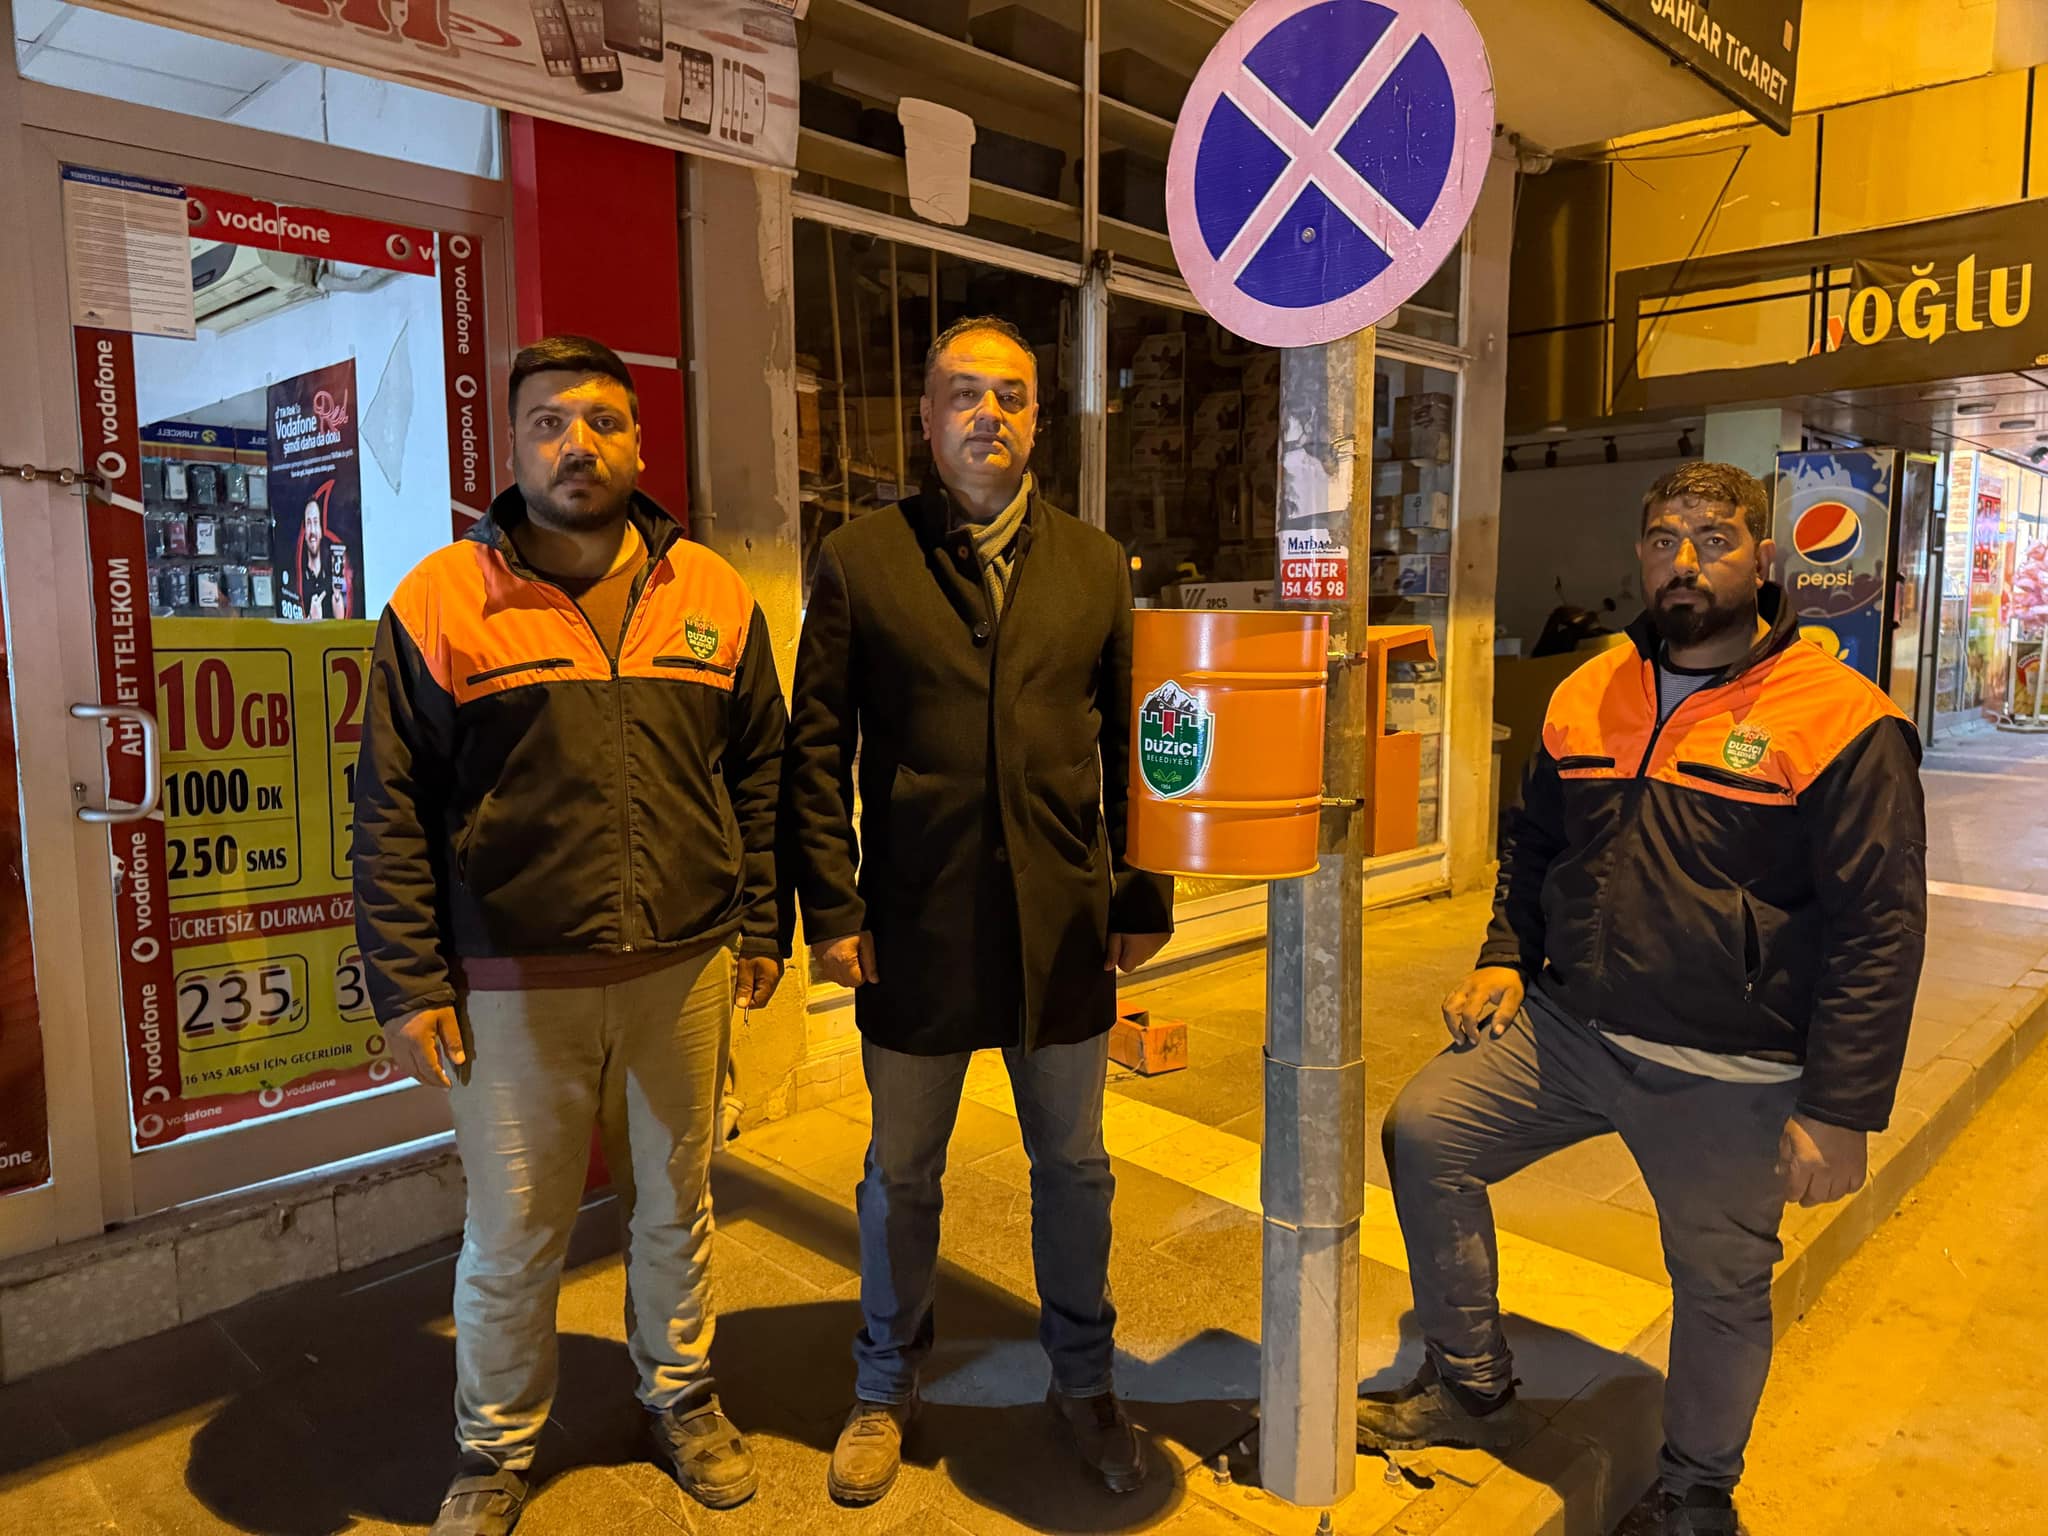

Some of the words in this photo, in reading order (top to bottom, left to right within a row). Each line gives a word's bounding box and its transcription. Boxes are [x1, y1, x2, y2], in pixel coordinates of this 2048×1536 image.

[216, 210, 331, 244] vodafone
[454, 265, 472, 355] vodafone
[94, 339, 119, 444] vodafone
[275, 415, 317, 440] Vodafone
[461, 405, 478, 492] vodafone
[1287, 562, 1339, 578] CENTER
[1304, 581, 1322, 596] 45
[1326, 581, 1345, 597] 98
[1796, 569, 1853, 590] pepsi
[108, 558, 136, 664] TELEKOM
[158, 658, 235, 752] 10
[241, 692, 291, 748] GB
[1144, 738, 1198, 758] DÜZİÇİ
[1146, 754, 1193, 766] BELEDİYESİ
[165, 768, 249, 817] 1000
[257, 785, 283, 811] DK
[167, 835, 239, 880] 250
[247, 847, 287, 872] SMS
[129, 831, 152, 931] vodafone
[169, 910, 254, 942] ÜCRETSİZ
[260, 903, 325, 929] DURMA
[141, 984, 161, 1081] vodafone
[202, 1069, 223, 1082] YAŞ
[225, 1062, 260, 1076] ARASI
[264, 1057, 288, 1072] İÇİN
[291, 1043, 353, 1065] GEÇERLİDİR
[285, 1078, 337, 1097] vodafone
[166, 1104, 223, 1127] vodafone
